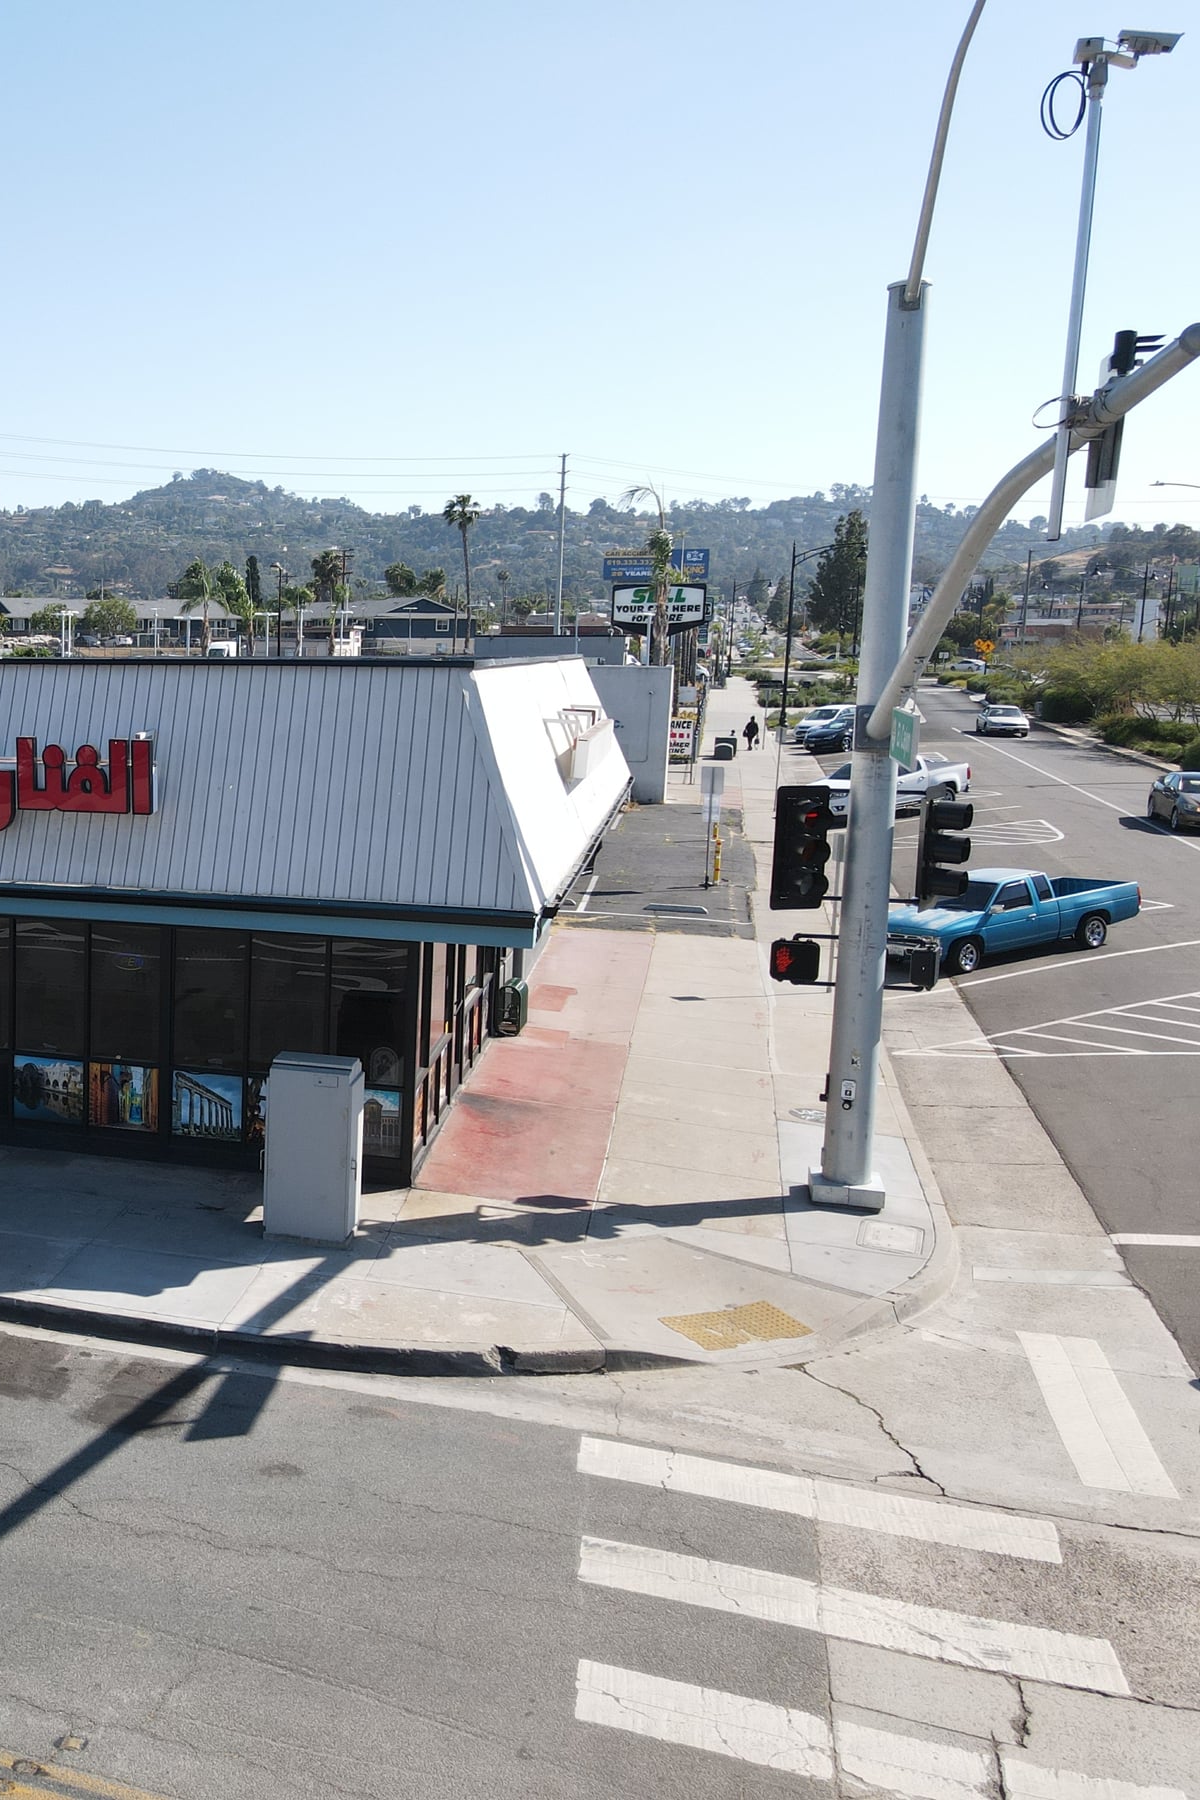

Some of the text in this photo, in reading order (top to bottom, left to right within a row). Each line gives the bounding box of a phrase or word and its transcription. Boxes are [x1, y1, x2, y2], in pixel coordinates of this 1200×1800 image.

[631, 588, 687, 604] SEL
[616, 604, 701, 613] YOUR CR HERE
